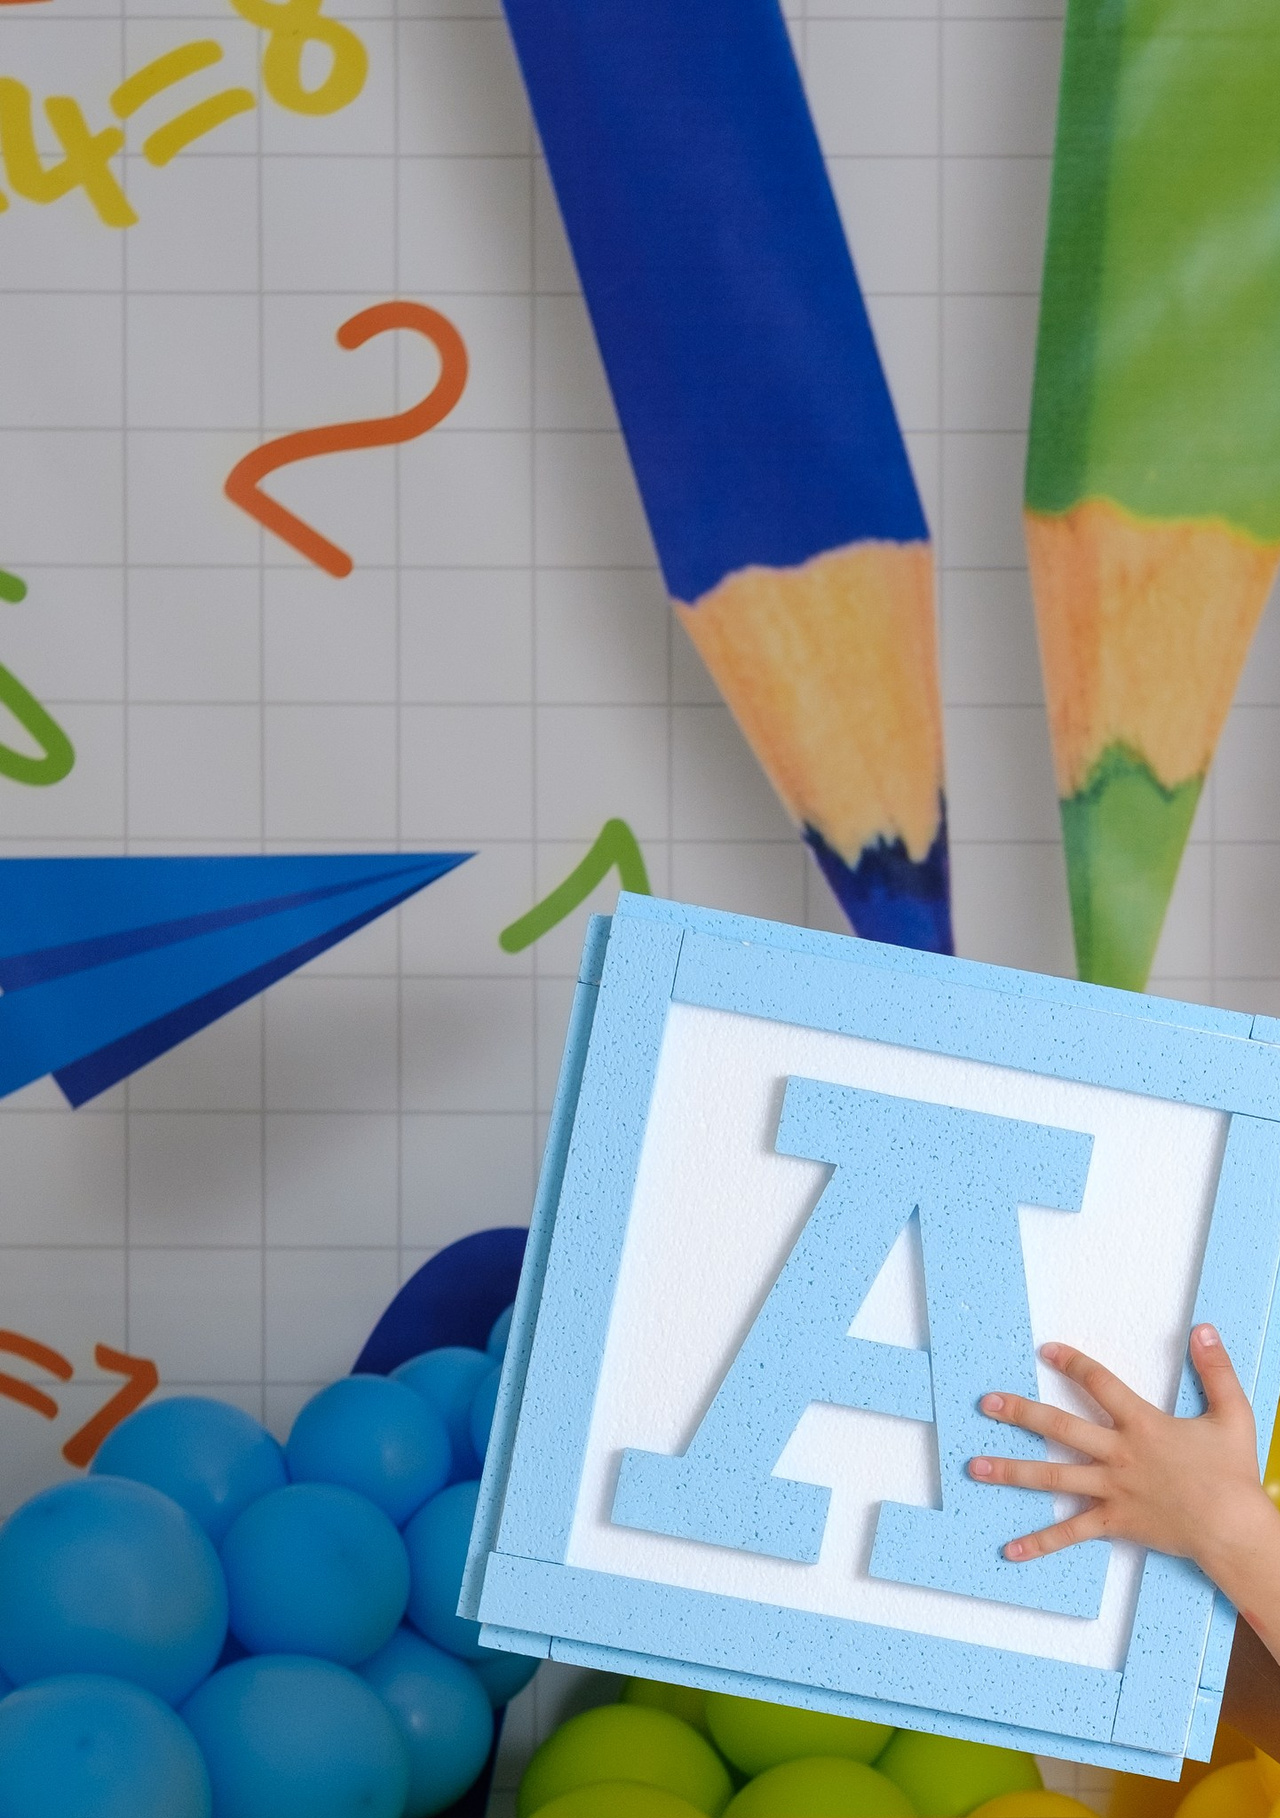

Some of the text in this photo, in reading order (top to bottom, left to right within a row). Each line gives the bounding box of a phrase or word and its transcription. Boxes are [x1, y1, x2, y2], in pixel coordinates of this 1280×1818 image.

[0, 0, 368, 228] 4=8
[224, 300, 469, 579] 2
[611, 1074, 1111, 1621] A
